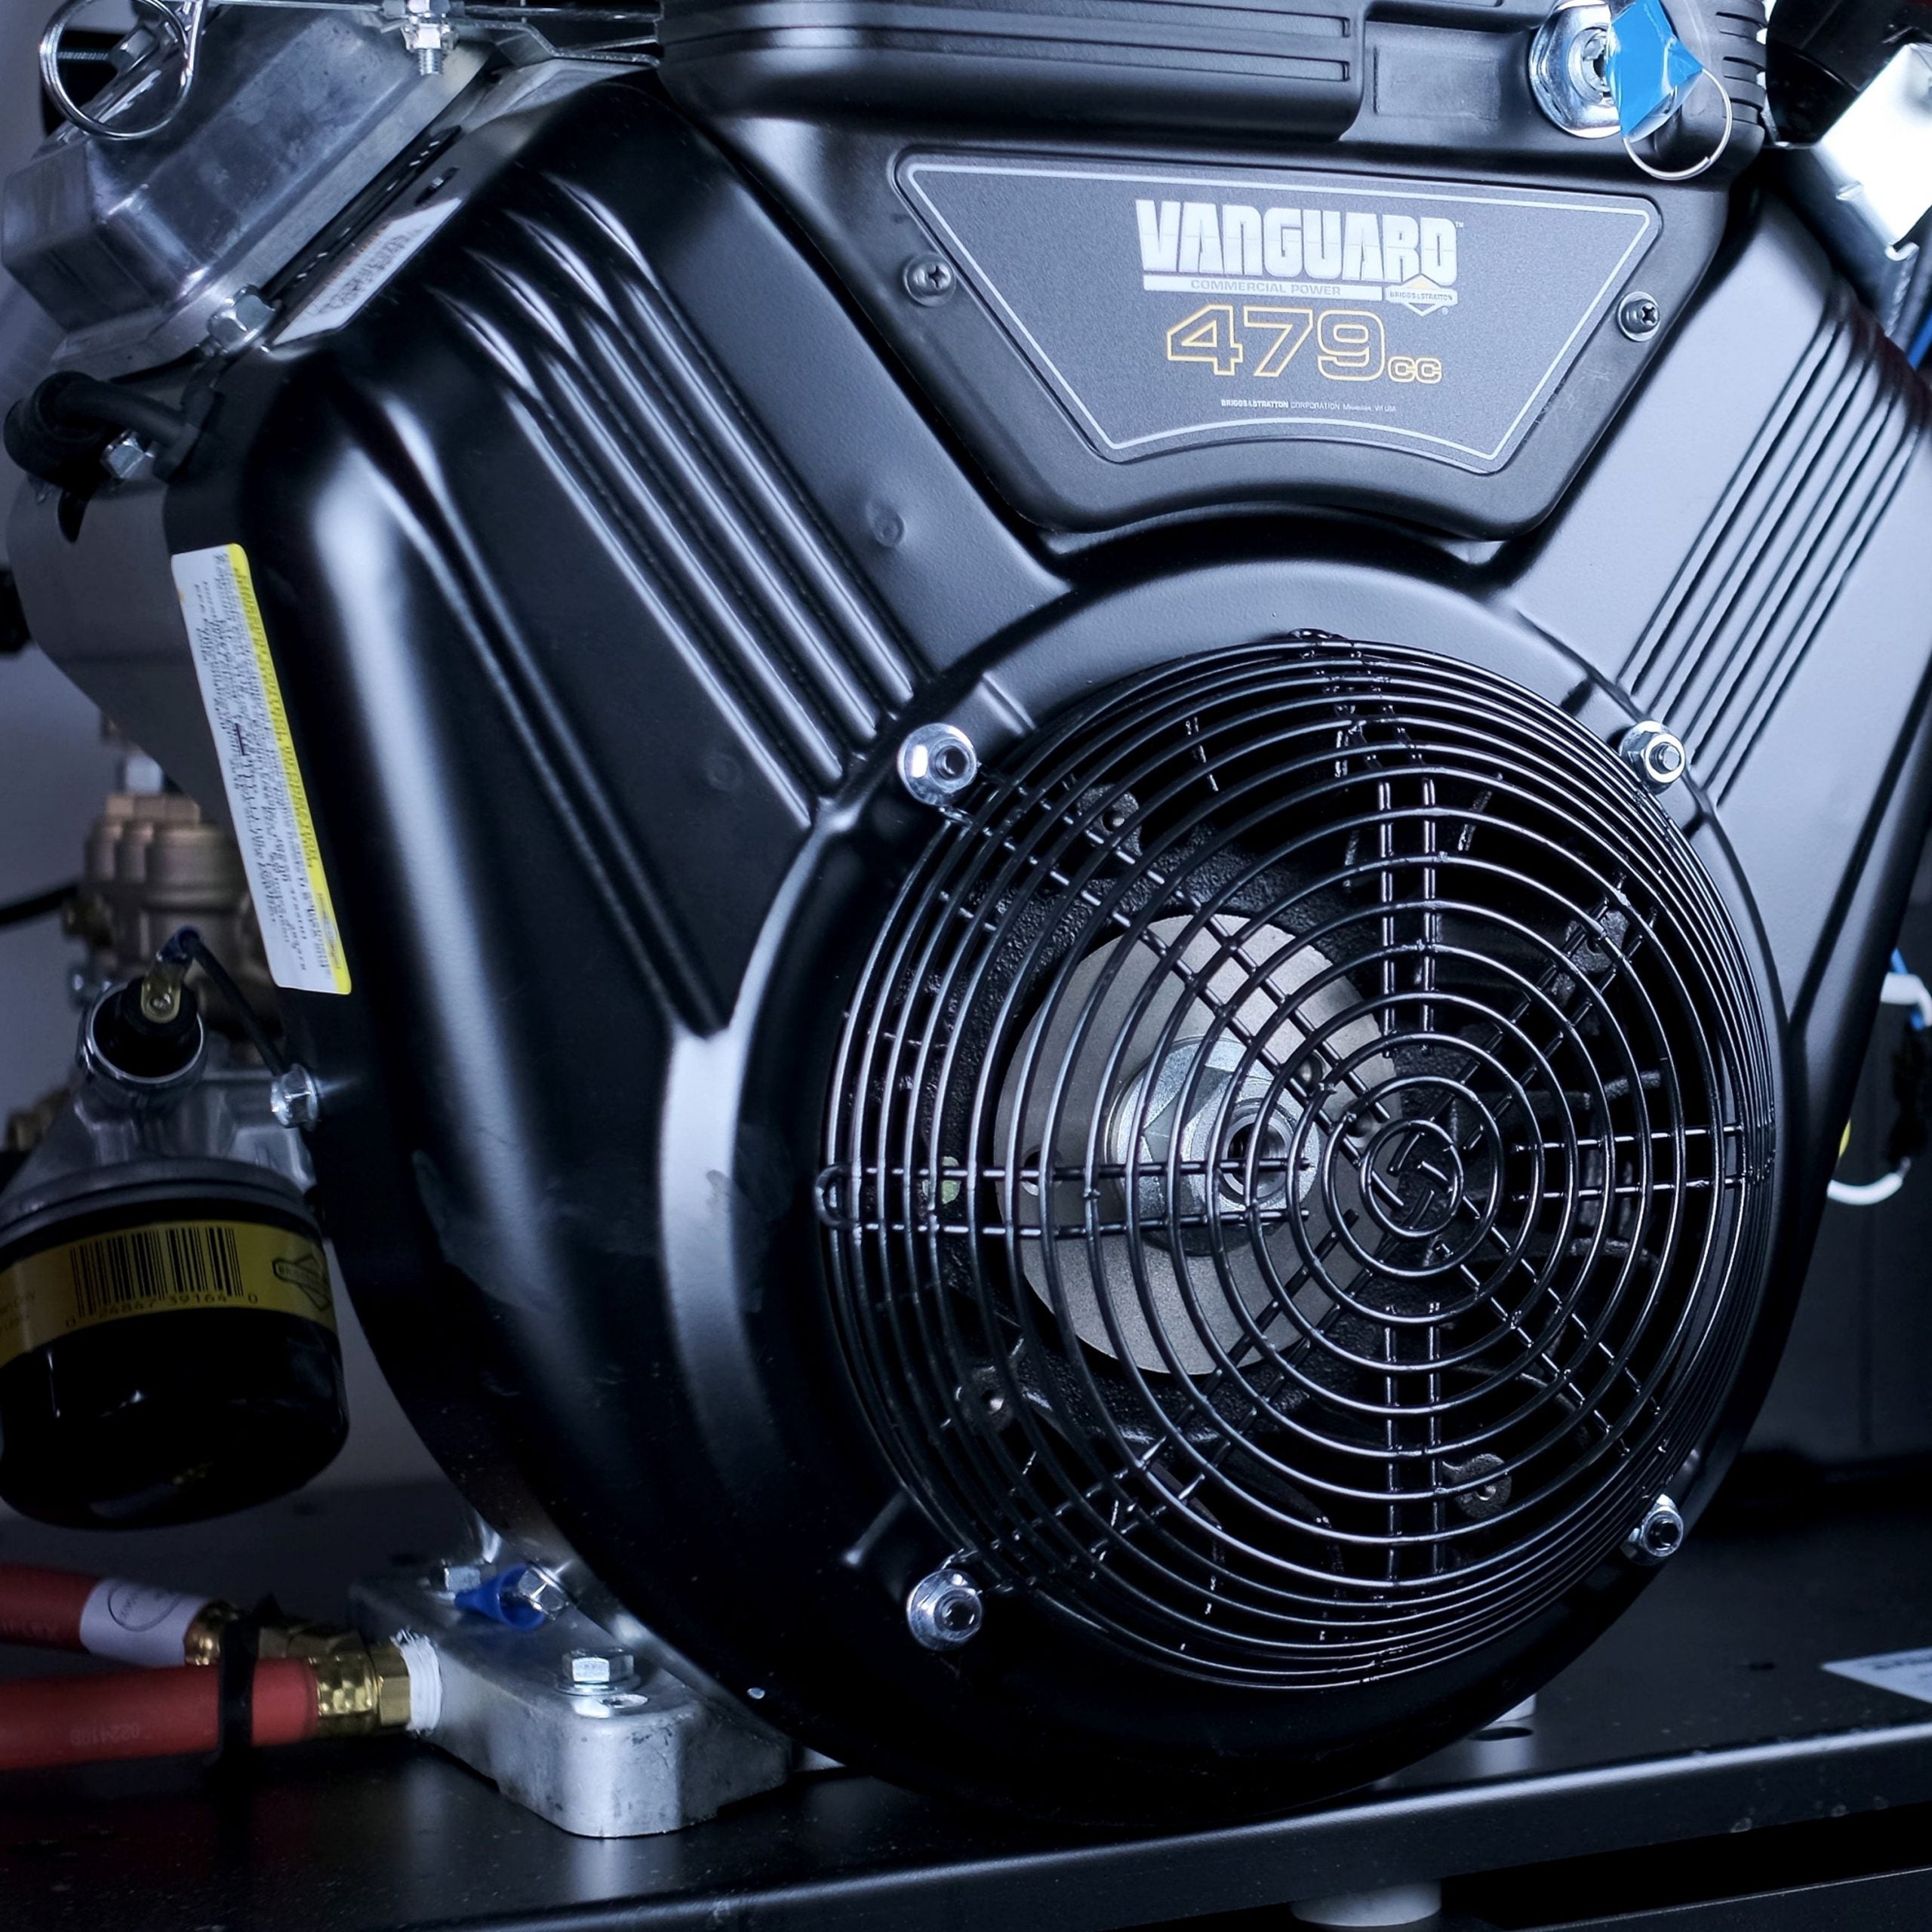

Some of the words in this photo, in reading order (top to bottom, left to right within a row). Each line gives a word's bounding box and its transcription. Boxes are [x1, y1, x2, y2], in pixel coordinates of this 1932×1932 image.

[1135, 199, 1458, 286] VANGUARD
[1190, 279, 1286, 294] COMMERCIAL
[1291, 284, 1342, 297] POWER
